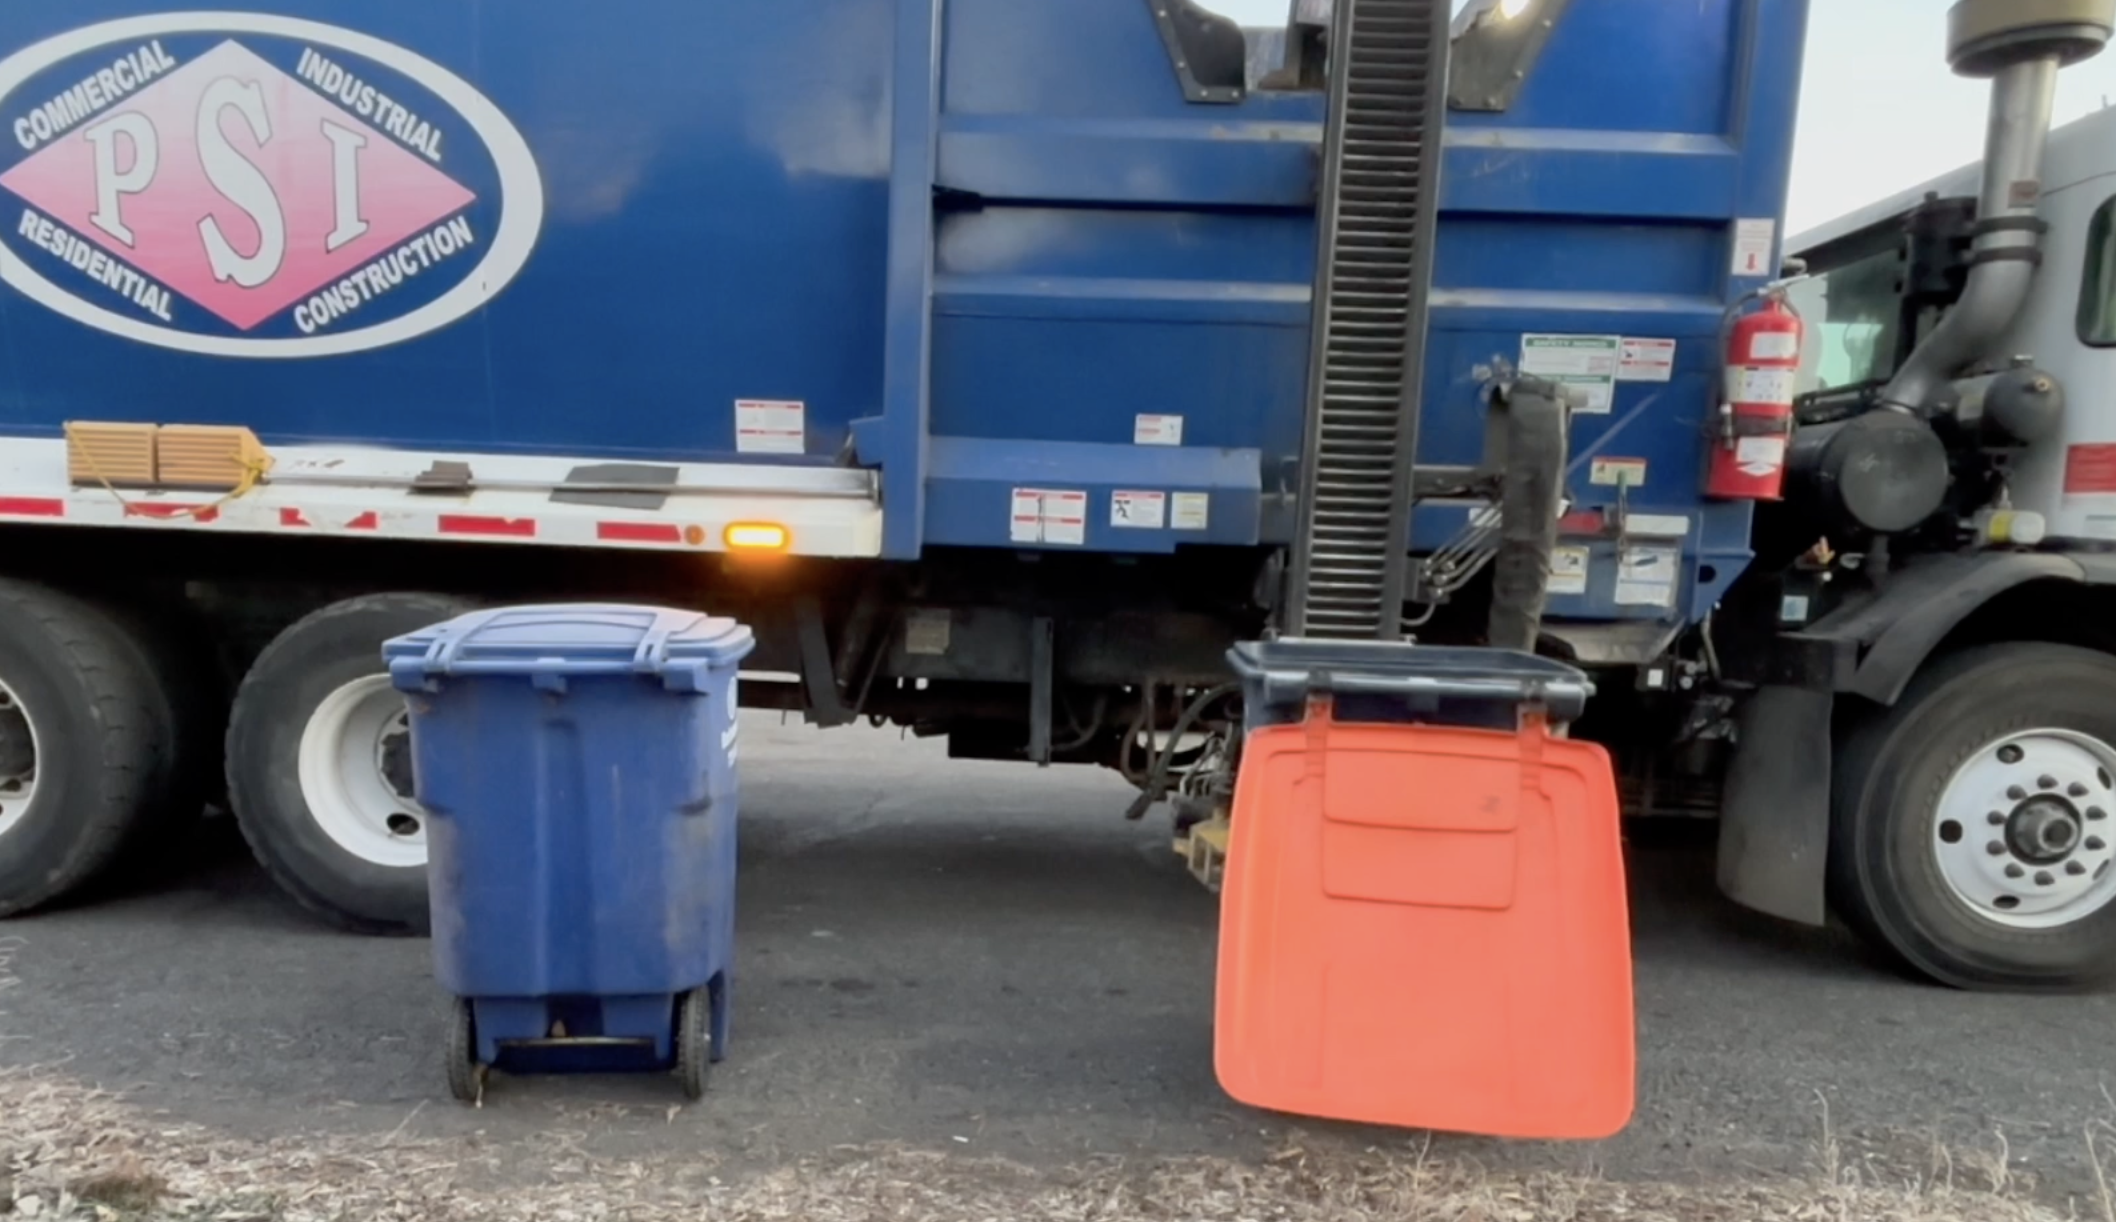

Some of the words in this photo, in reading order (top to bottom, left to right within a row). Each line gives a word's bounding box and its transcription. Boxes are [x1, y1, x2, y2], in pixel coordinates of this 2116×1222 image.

[14, 40, 175, 150] COMMERCIAL
[297, 48, 440, 161] INDUSTRIAL
[84, 74, 370, 290] PSI
[19, 209, 170, 320] RESIDENTIAL
[295, 216, 473, 333] CONSTRUCTION
